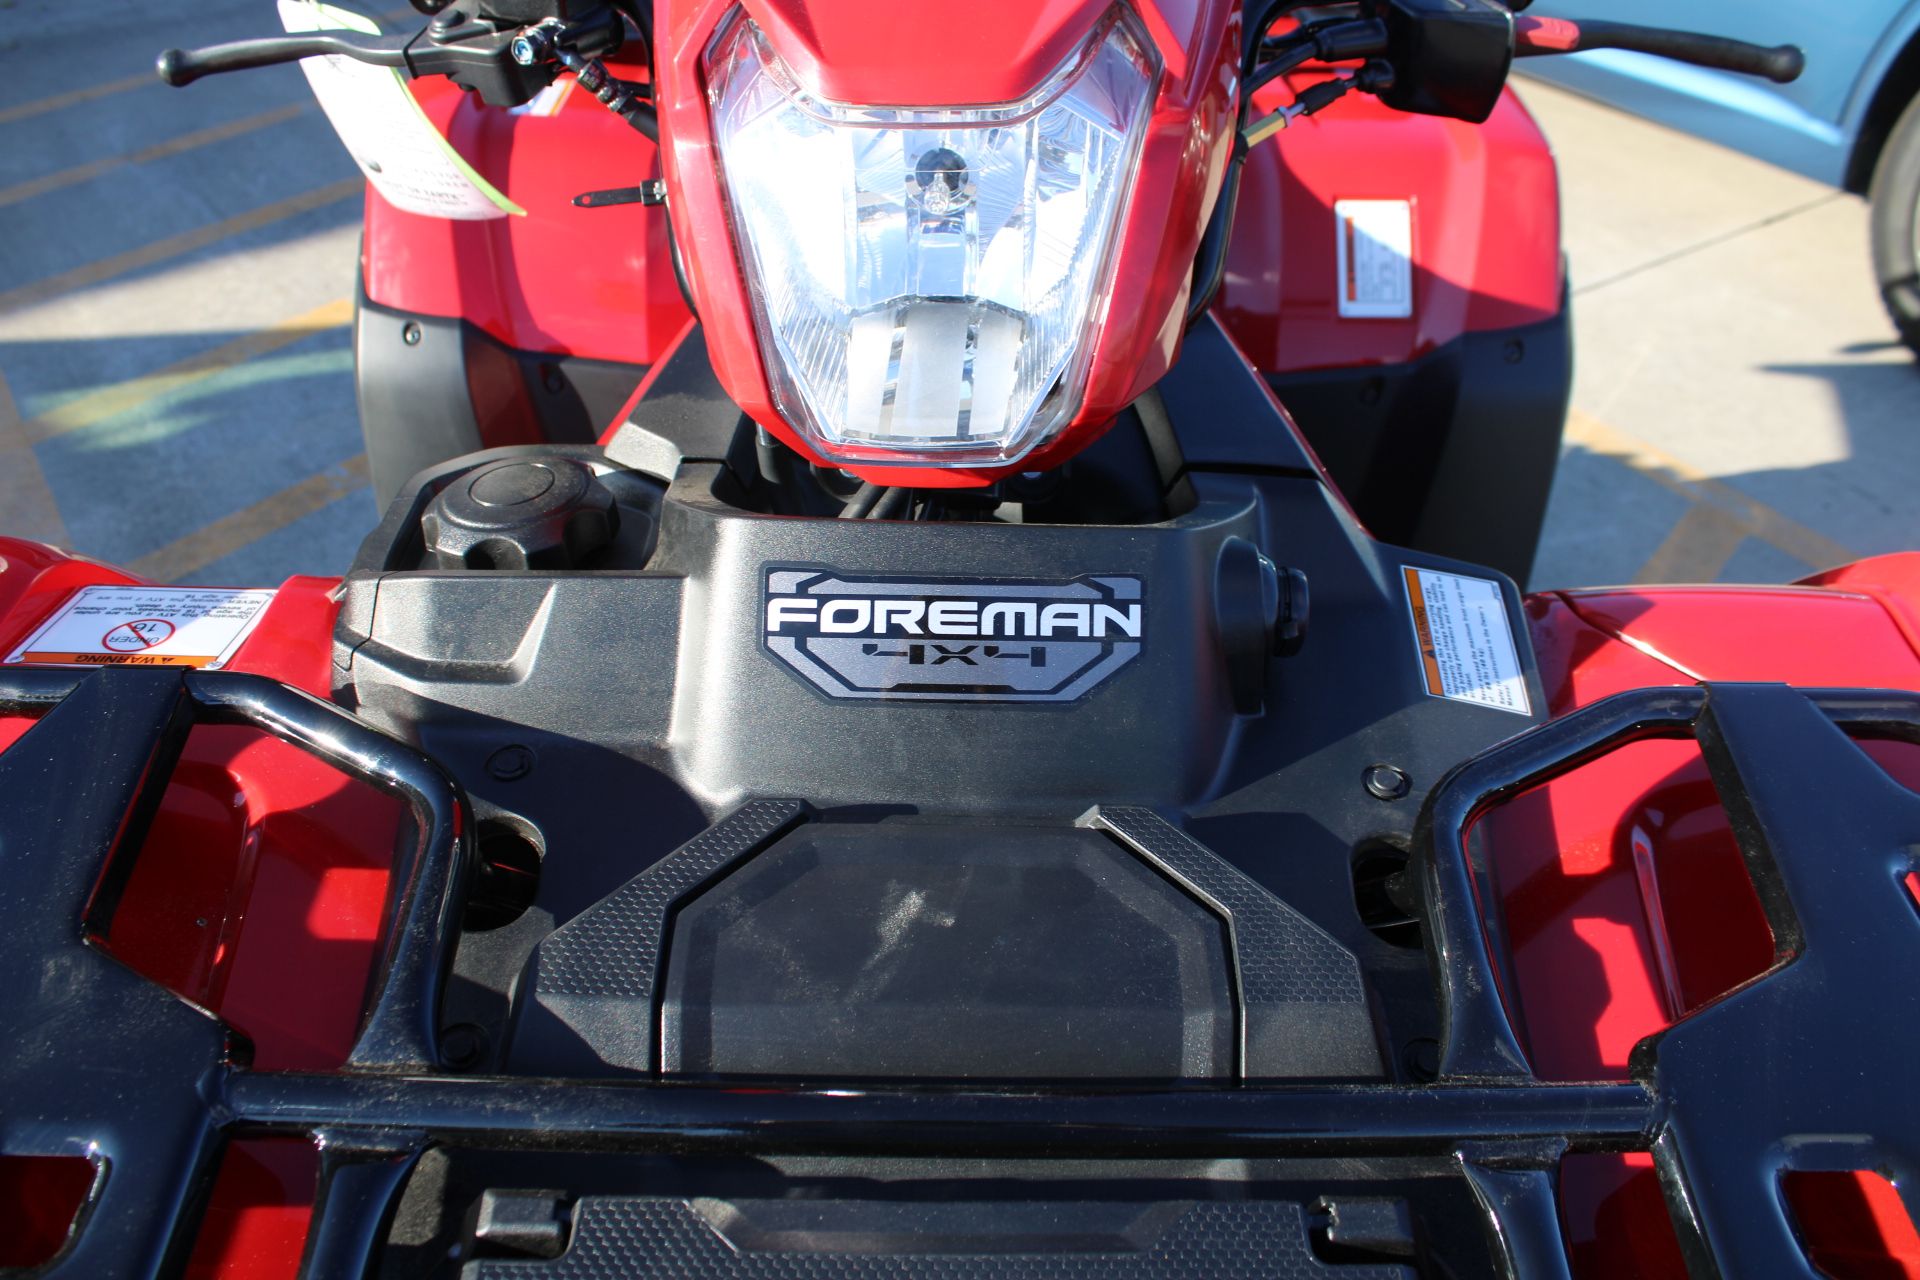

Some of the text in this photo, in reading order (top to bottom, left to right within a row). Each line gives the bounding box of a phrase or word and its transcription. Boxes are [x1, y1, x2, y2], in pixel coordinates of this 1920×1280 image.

[130, 623, 157, 633] 16
[767, 598, 1142, 637] FOREMAN
[1415, 606, 1432, 646] WARNING
[74, 654, 156, 664] WARNING
